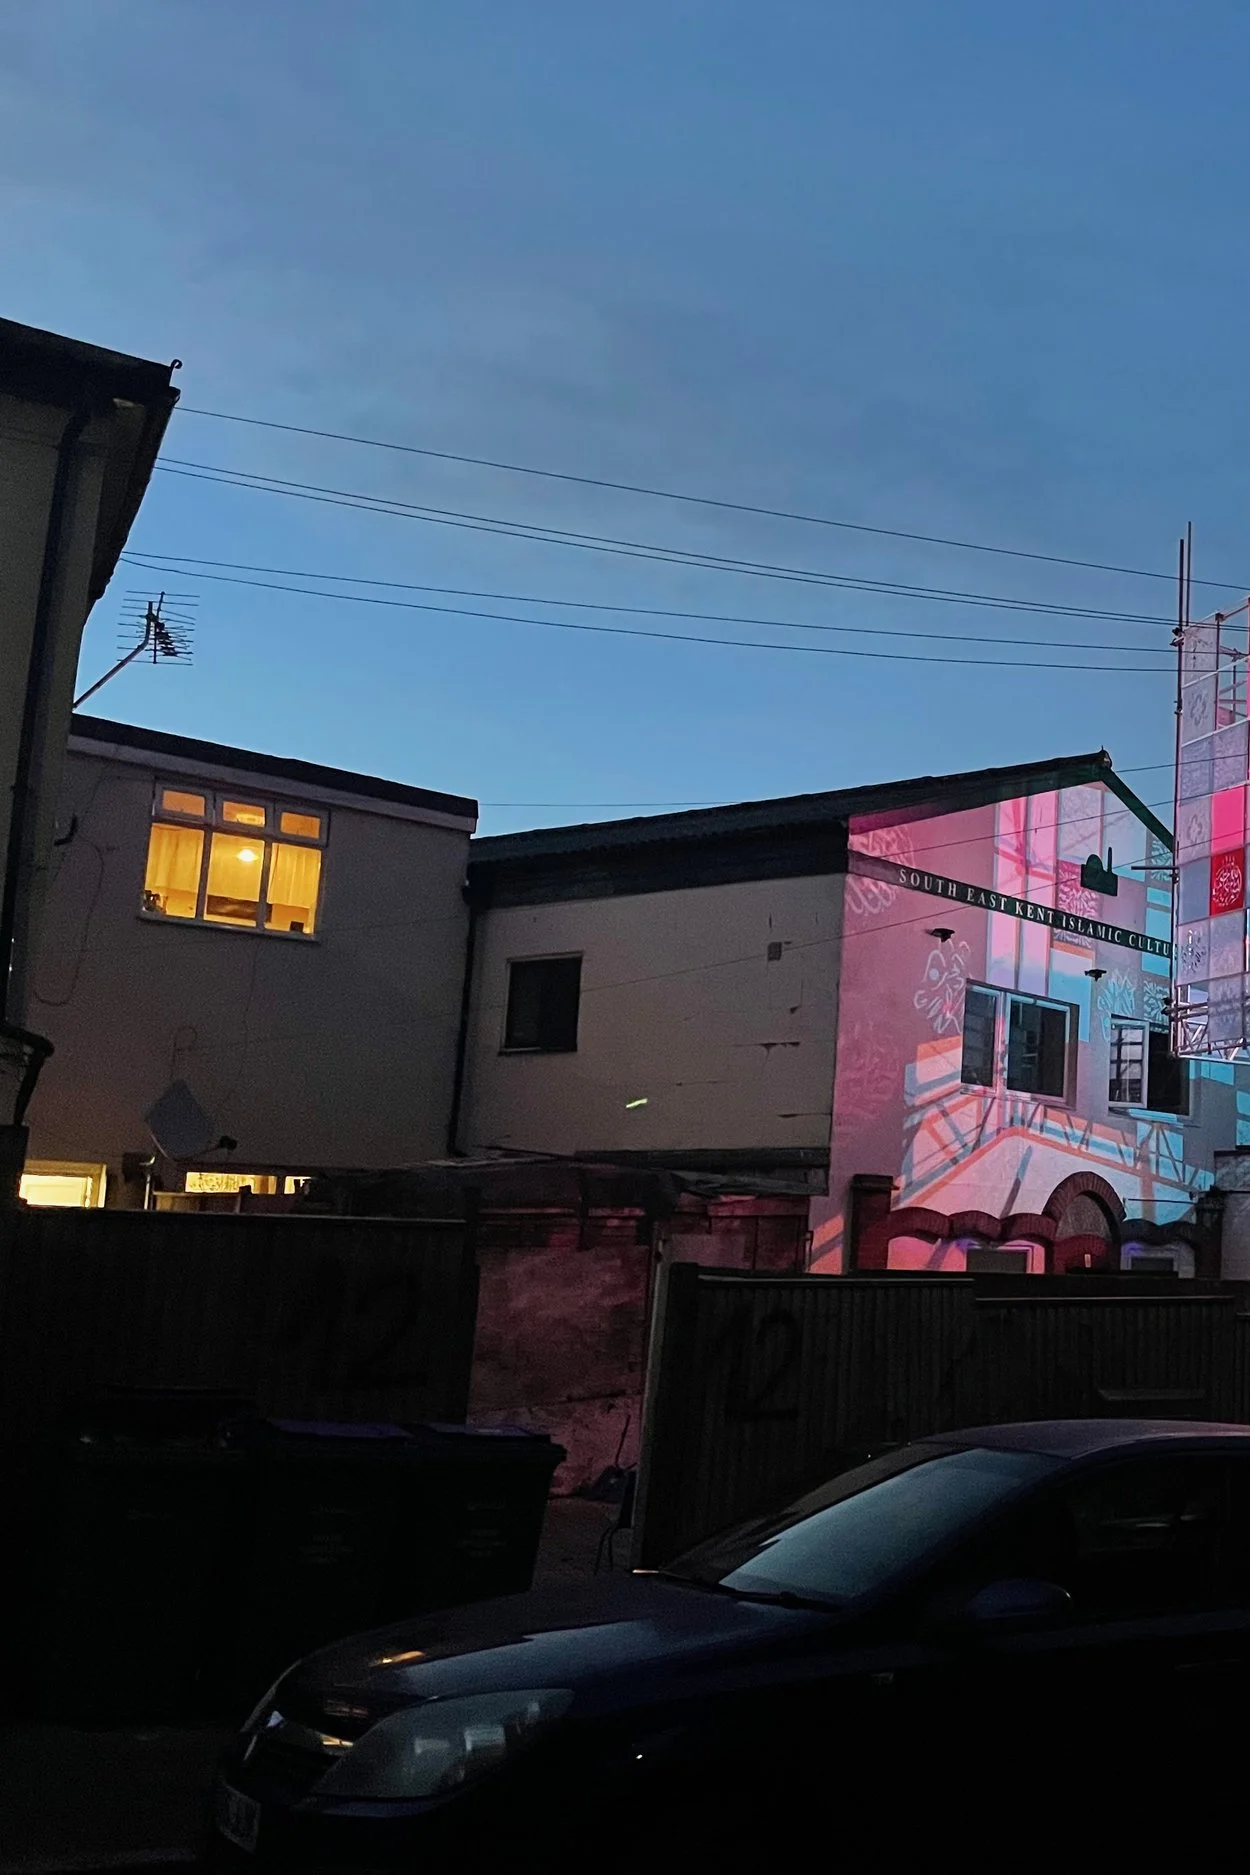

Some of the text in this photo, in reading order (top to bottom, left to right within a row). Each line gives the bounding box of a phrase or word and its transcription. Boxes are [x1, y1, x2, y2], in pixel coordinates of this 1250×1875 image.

[899, 868, 957, 898] SOUTH
[967, 888, 1008, 911] EAST
[1015, 900, 1055, 924] KENT
[1062, 911, 1122, 943] ISLAMIC
